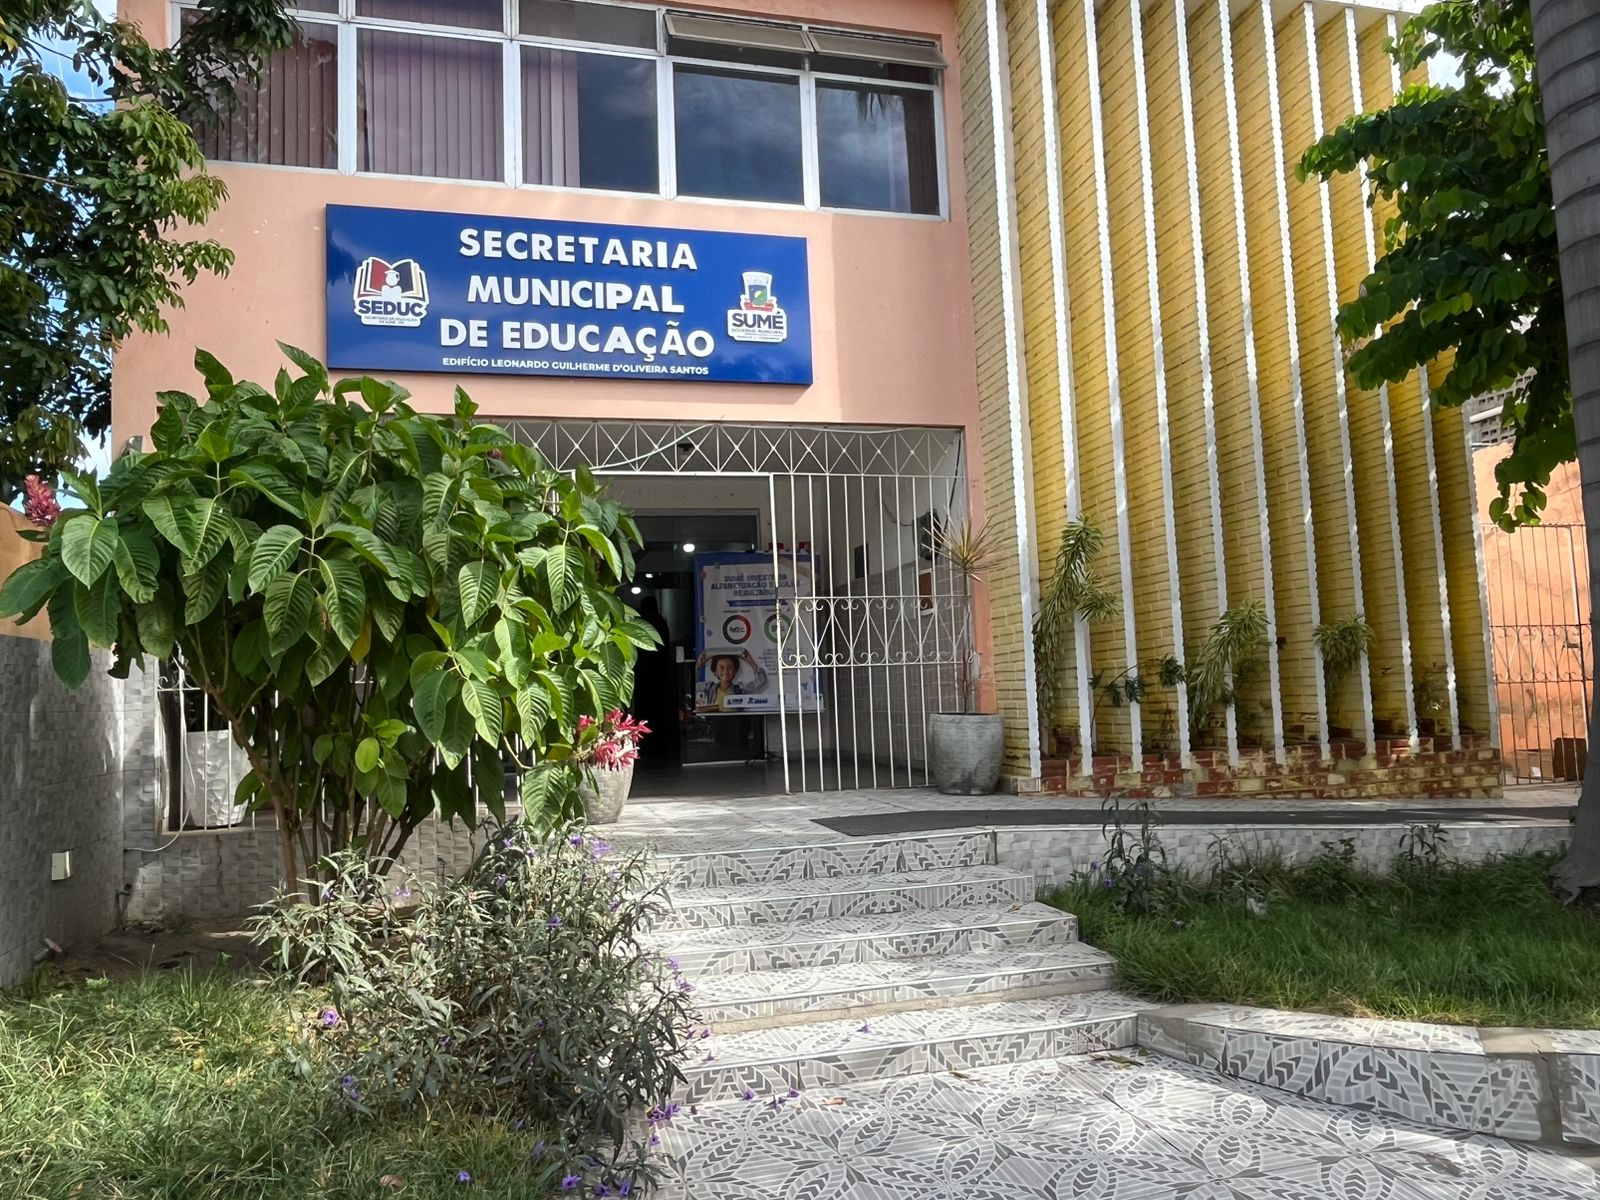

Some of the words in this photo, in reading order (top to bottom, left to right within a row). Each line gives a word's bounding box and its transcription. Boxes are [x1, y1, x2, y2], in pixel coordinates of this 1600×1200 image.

[459, 228, 698, 270] SECRETARIA
[358, 300, 424, 317] SEDUC
[467, 275, 685, 313] MUNICIPAL
[732, 310, 784, 330] SUMÉ
[440, 318, 488, 347] DE
[502, 320, 715, 362] EDUCAÇÃO
[442, 356, 489, 367] EDIFÍCIO
[491, 358, 550, 369] LEONARDO
[551, 361, 611, 372] GUILHERME
[669, 366, 710, 375] SANTOS
